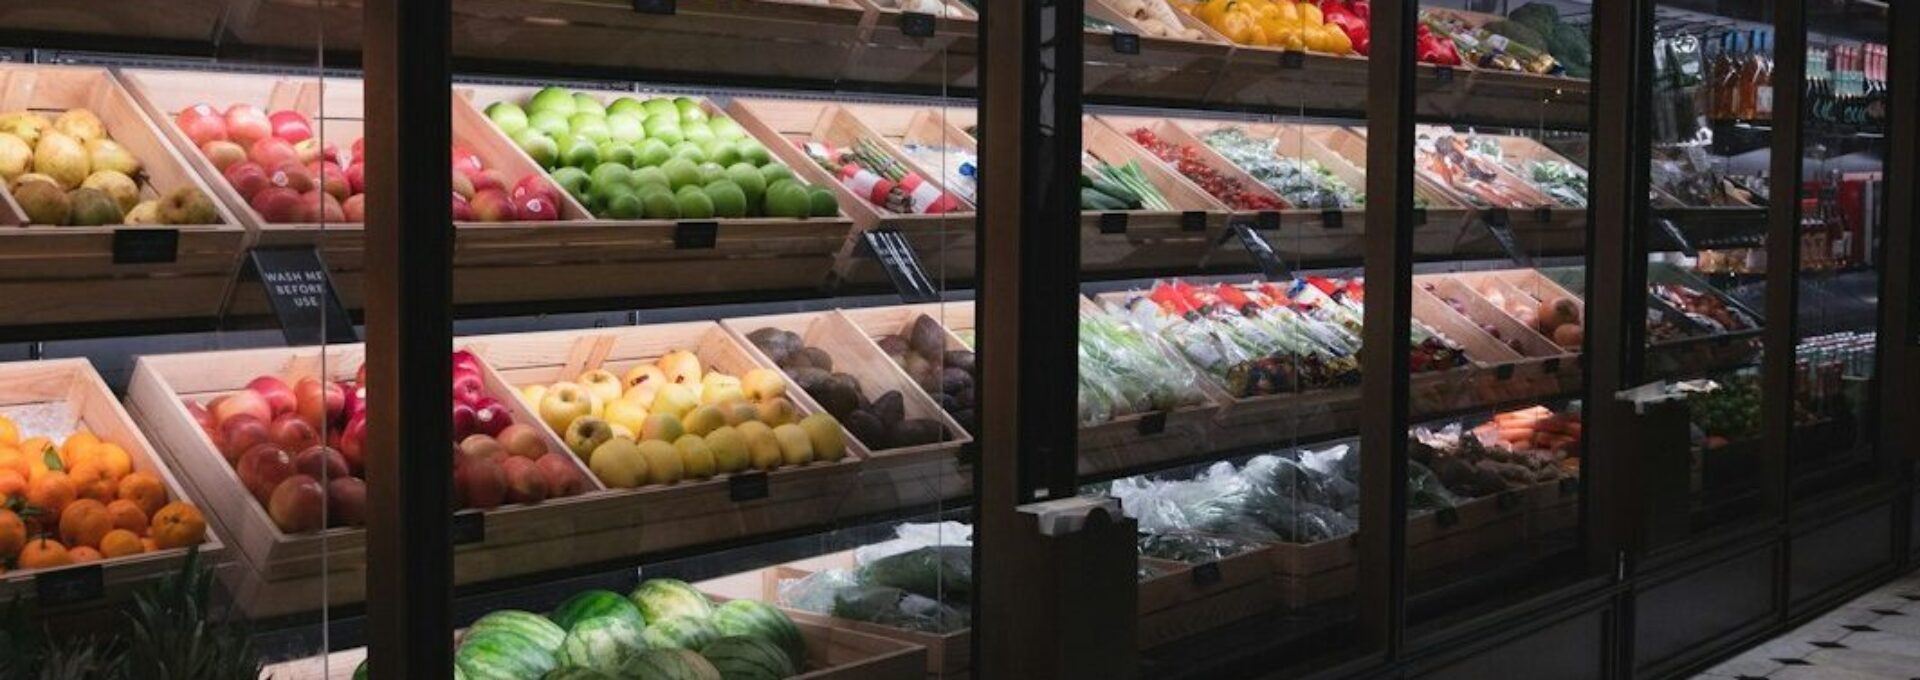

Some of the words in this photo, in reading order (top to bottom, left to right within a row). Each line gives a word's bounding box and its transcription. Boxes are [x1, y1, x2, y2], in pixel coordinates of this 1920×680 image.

[264, 271, 302, 281] WASH
[304, 270, 323, 280] ME
[275, 284, 323, 295] BEFORE
[293, 296, 319, 307] USE
